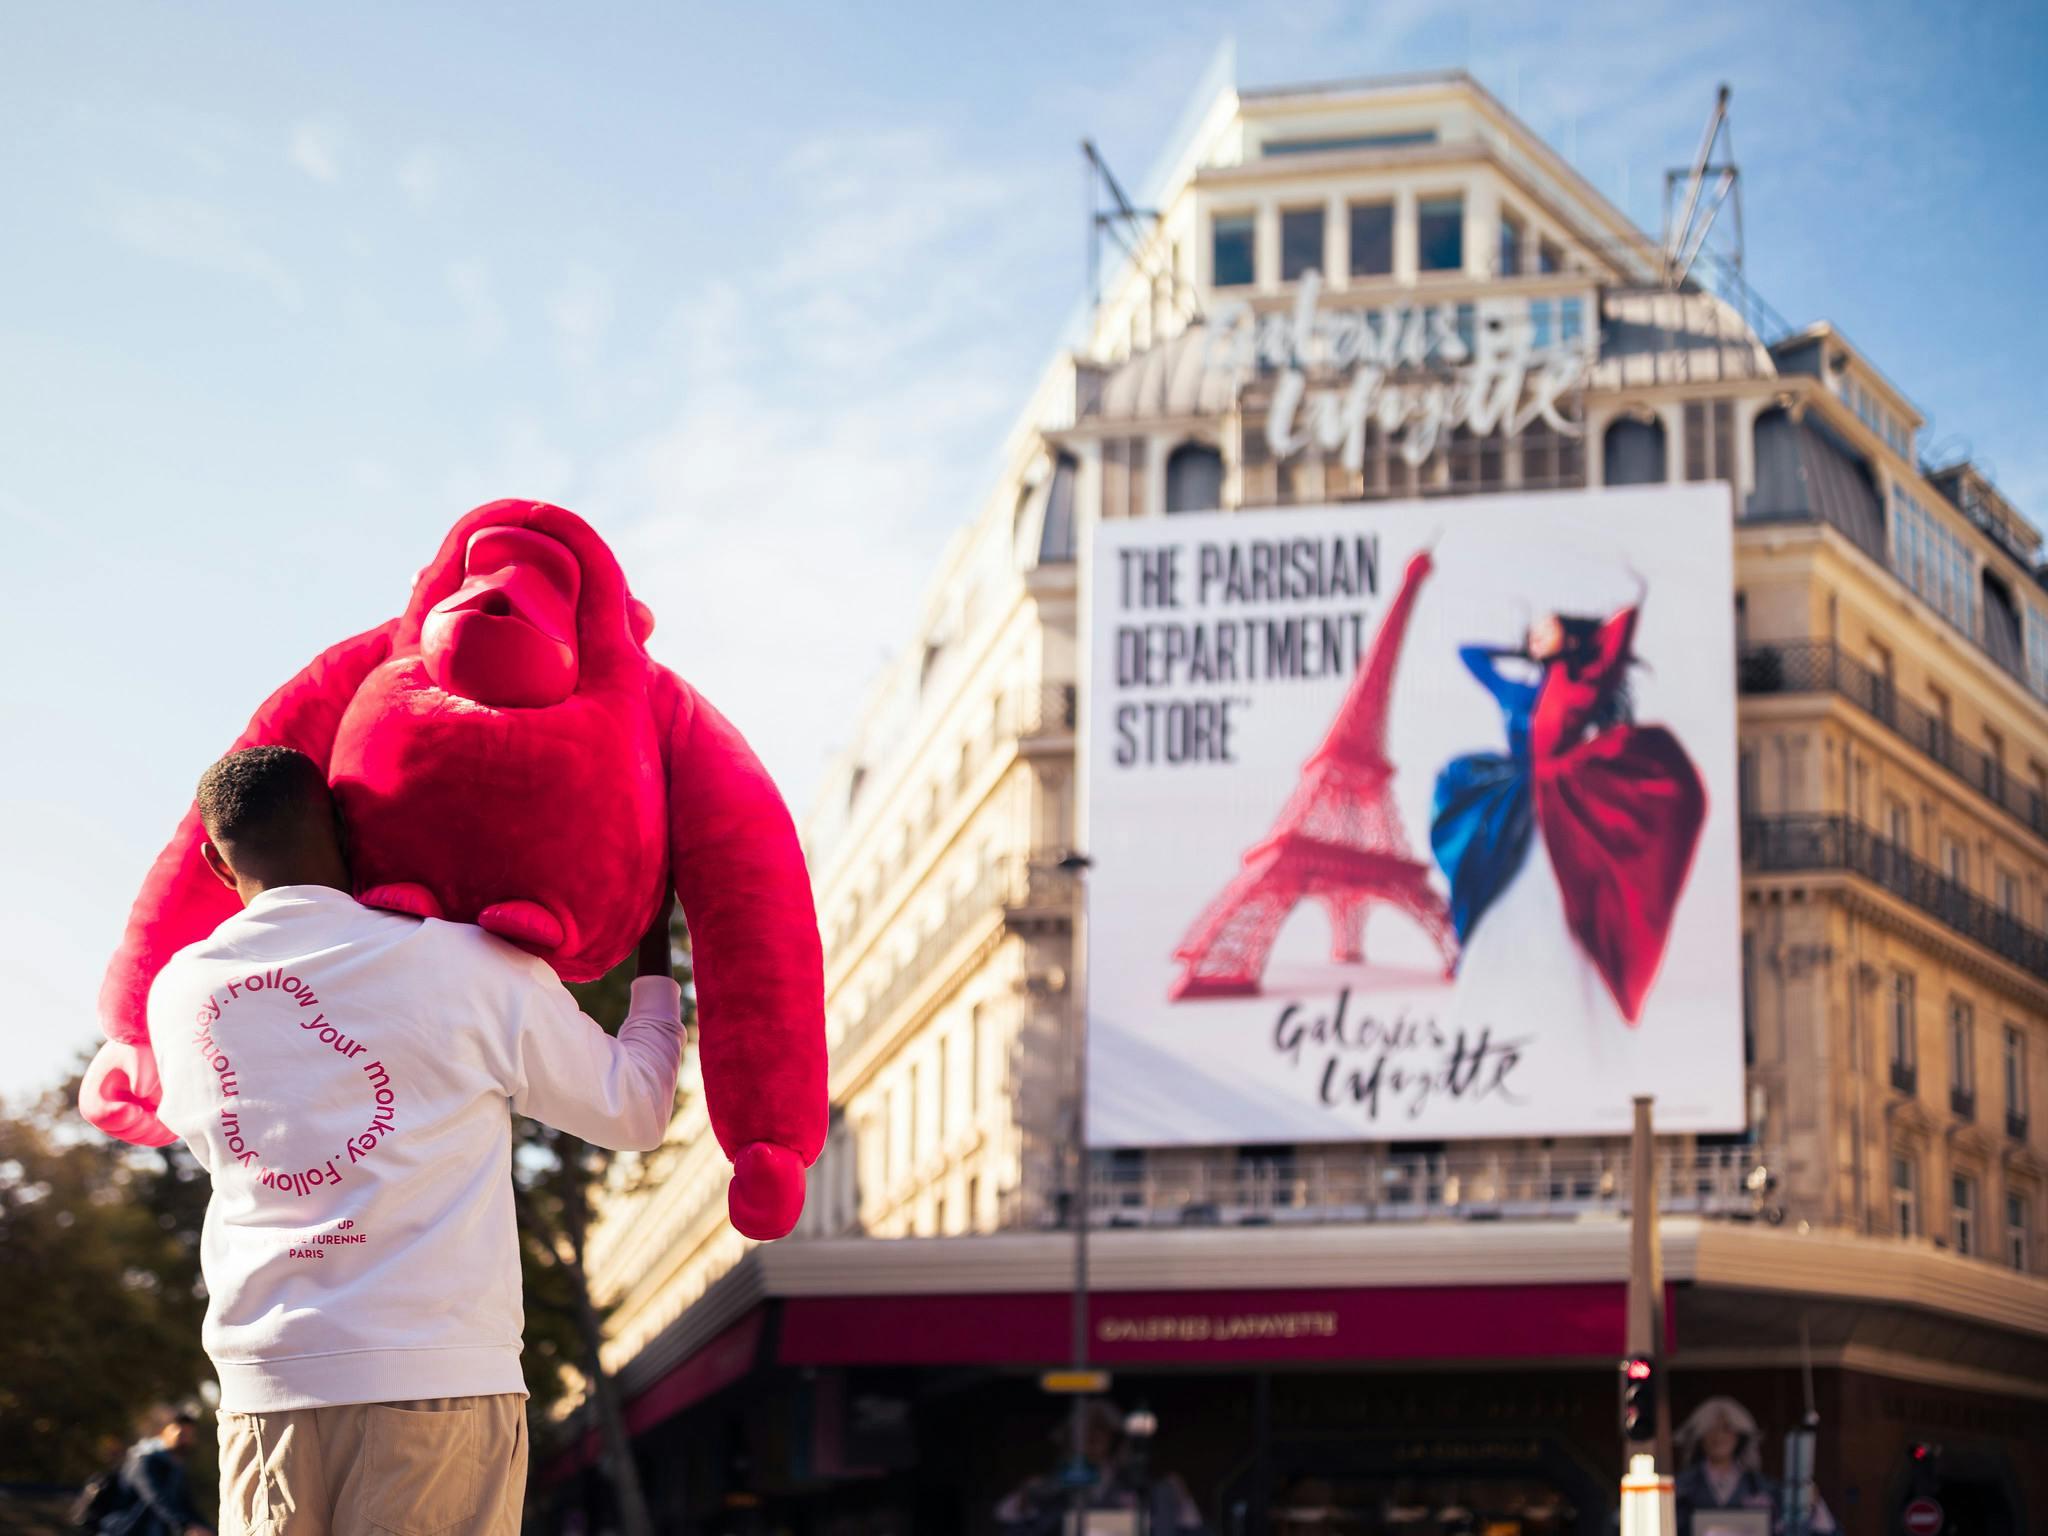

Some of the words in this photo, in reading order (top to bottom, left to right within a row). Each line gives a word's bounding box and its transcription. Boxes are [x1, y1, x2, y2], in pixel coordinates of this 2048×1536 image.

[1117, 546, 1182, 609] THE
[1199, 534, 1379, 605] PARISIAN
[1116, 613, 1365, 688] DEPARTMENT
[226, 967, 320, 1008] Follow
[300, 1012, 368, 1059] your
[220, 1108, 260, 1169] your
[256, 1159, 344, 1197] Follow
[289, 1248, 324, 1259] PARIS
[1097, 1316, 1211, 1343] GALERIES
[1213, 1311, 1338, 1341] LAFAYETTE
